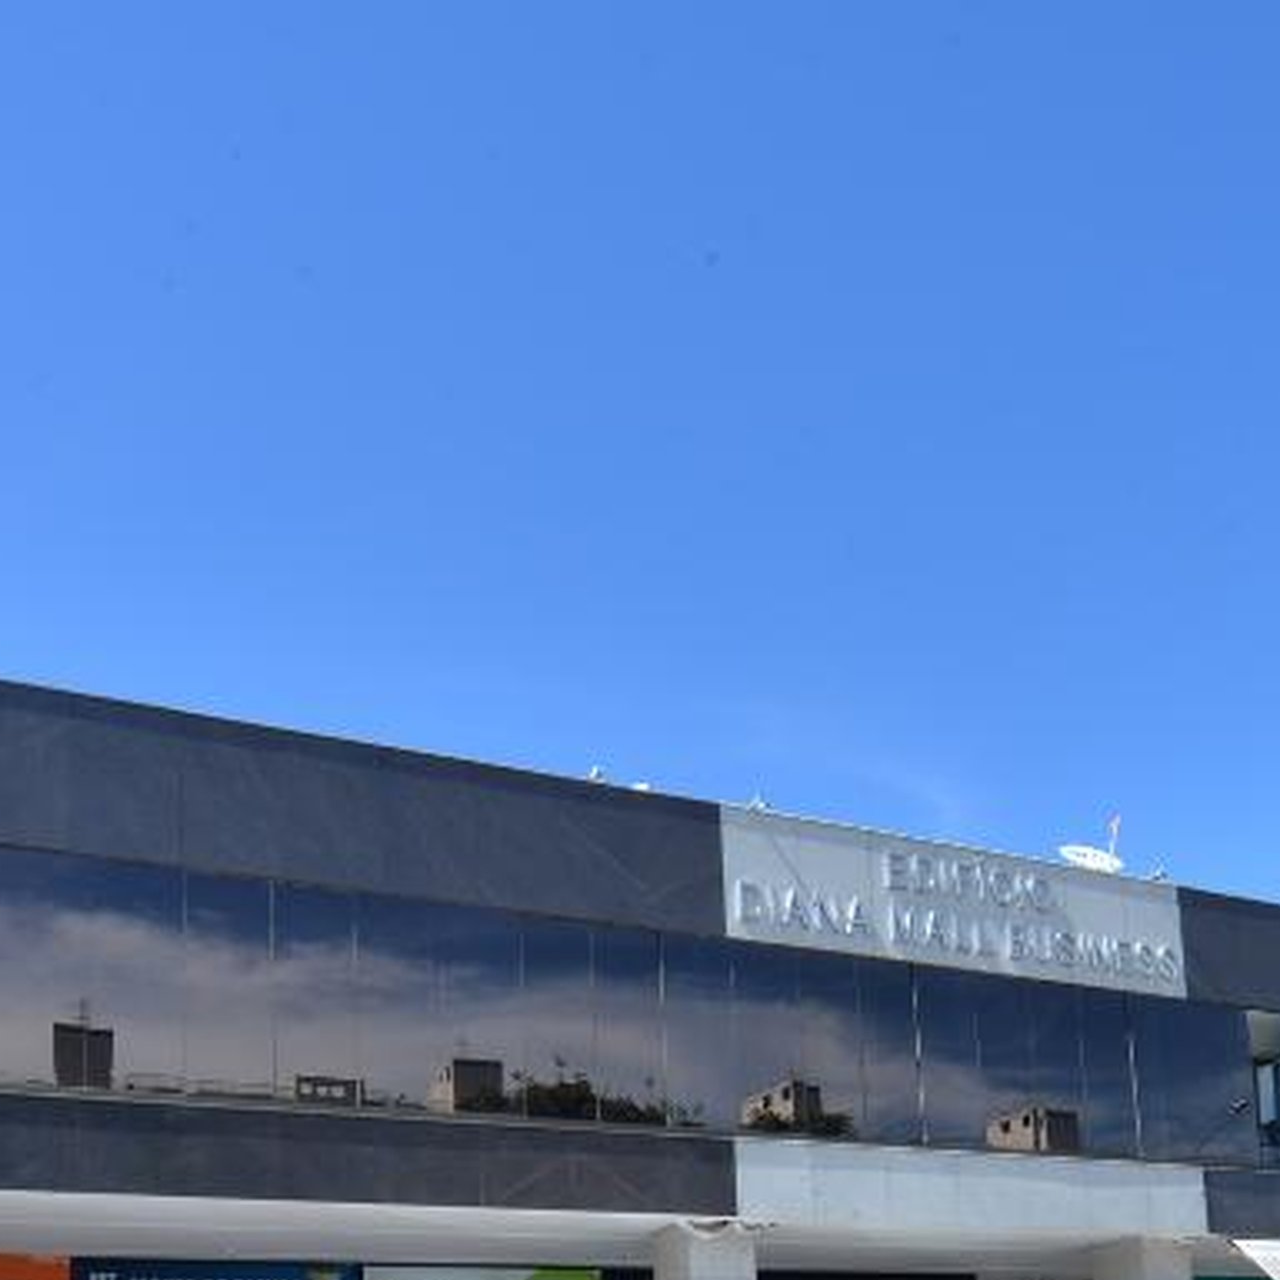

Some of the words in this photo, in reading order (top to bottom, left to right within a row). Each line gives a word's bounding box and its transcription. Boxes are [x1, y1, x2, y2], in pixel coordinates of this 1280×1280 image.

[735, 878, 869, 939] DIANA
[887, 906, 999, 957] MALL
[1008, 923, 1178, 982] BUSINESS
